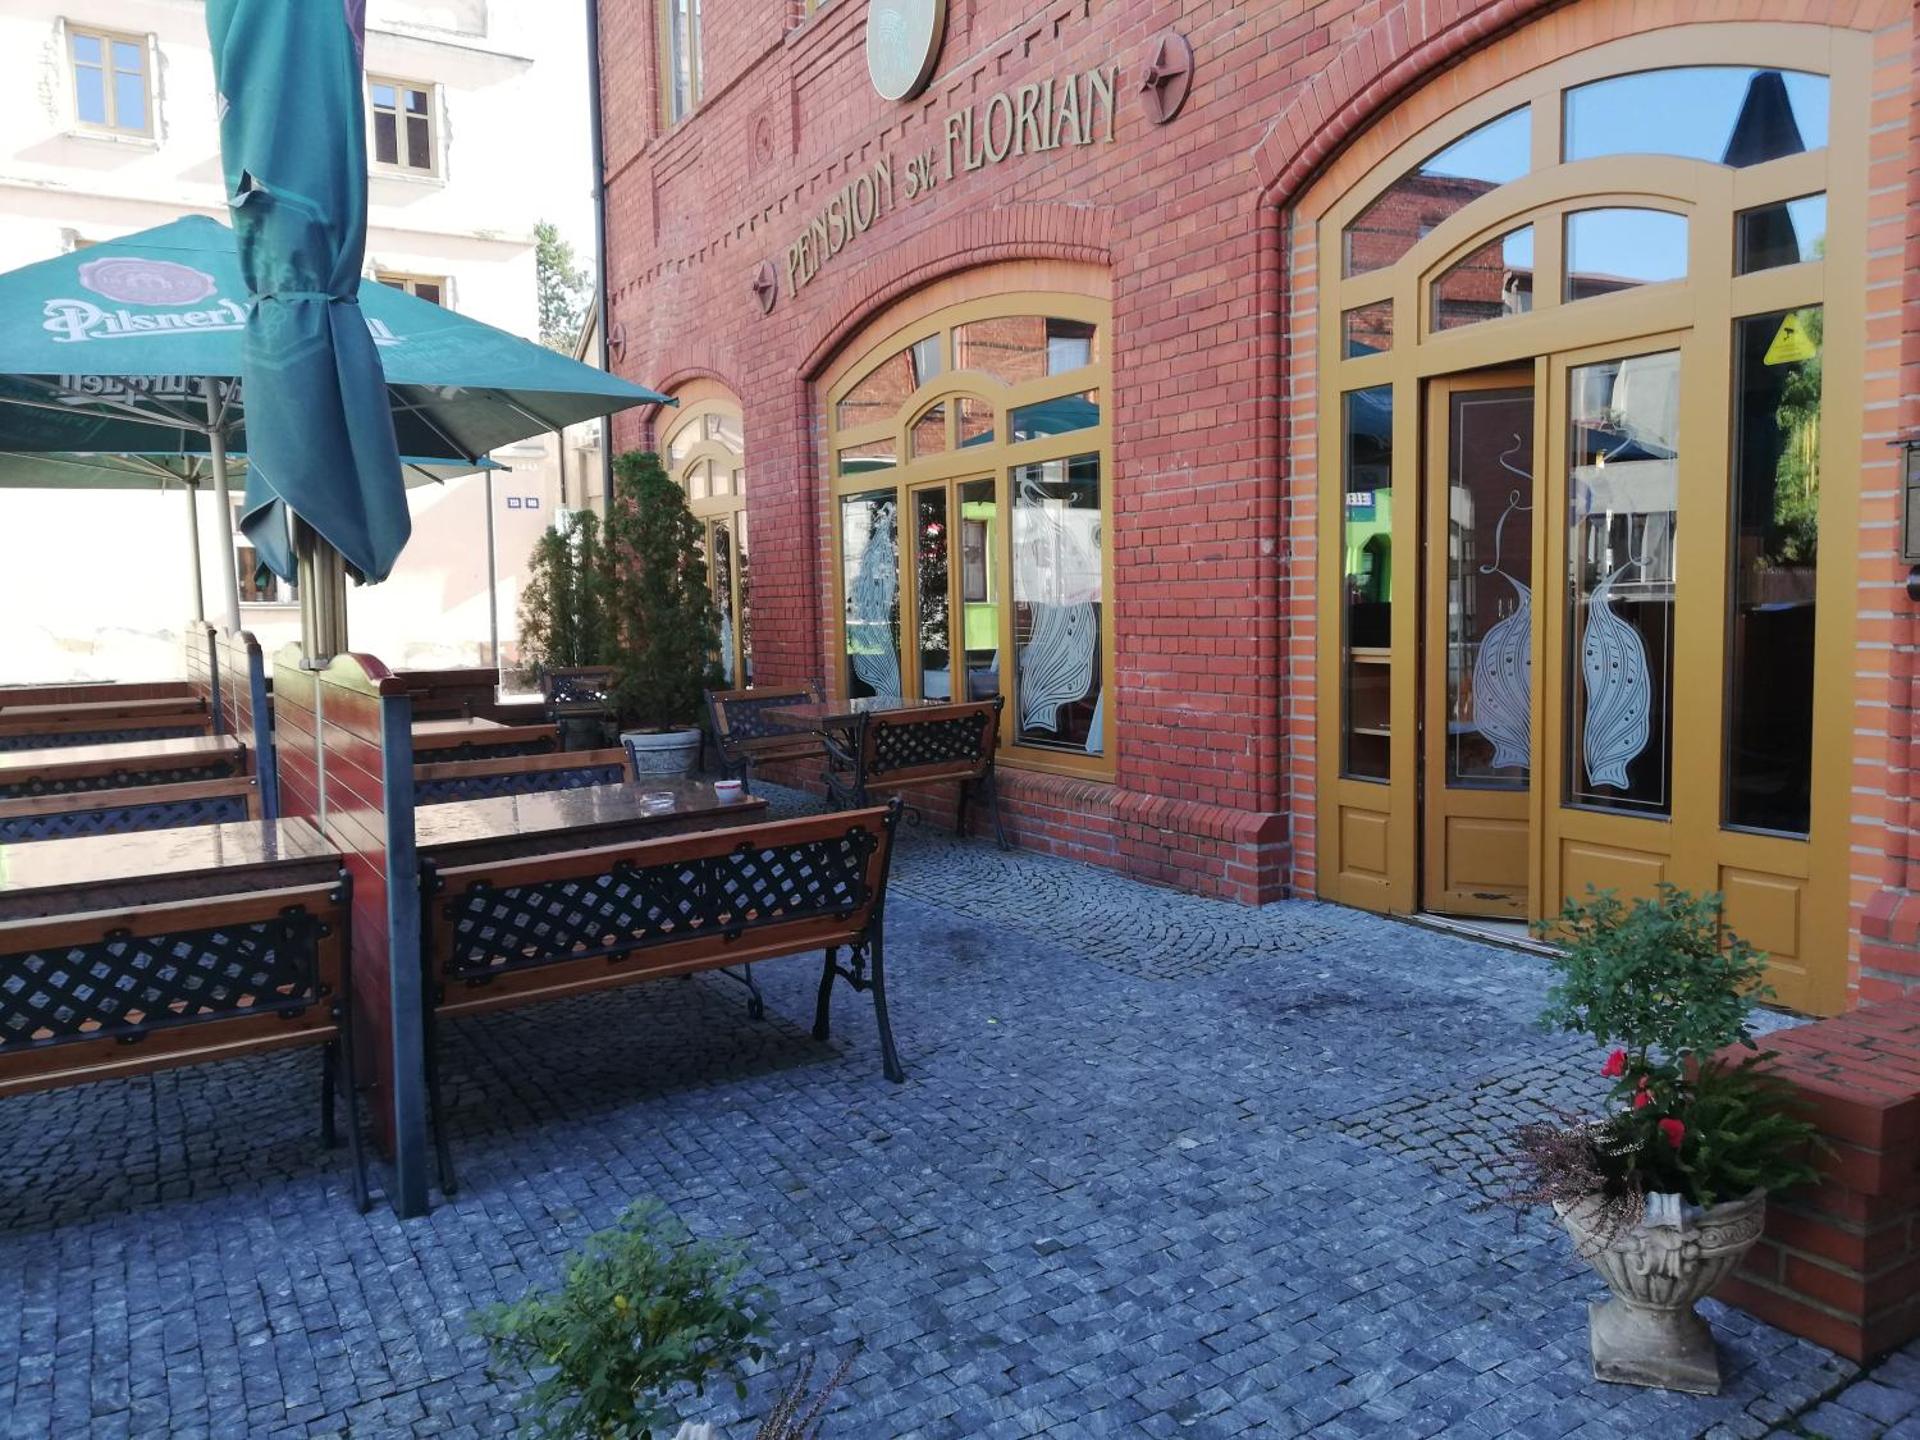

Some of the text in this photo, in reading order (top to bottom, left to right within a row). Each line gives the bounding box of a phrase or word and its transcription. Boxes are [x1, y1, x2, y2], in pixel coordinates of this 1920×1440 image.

[786, 151, 896, 299] PENSION
[943, 65, 1120, 181] FLORIAN
[42, 298, 232, 342] Pilsner
